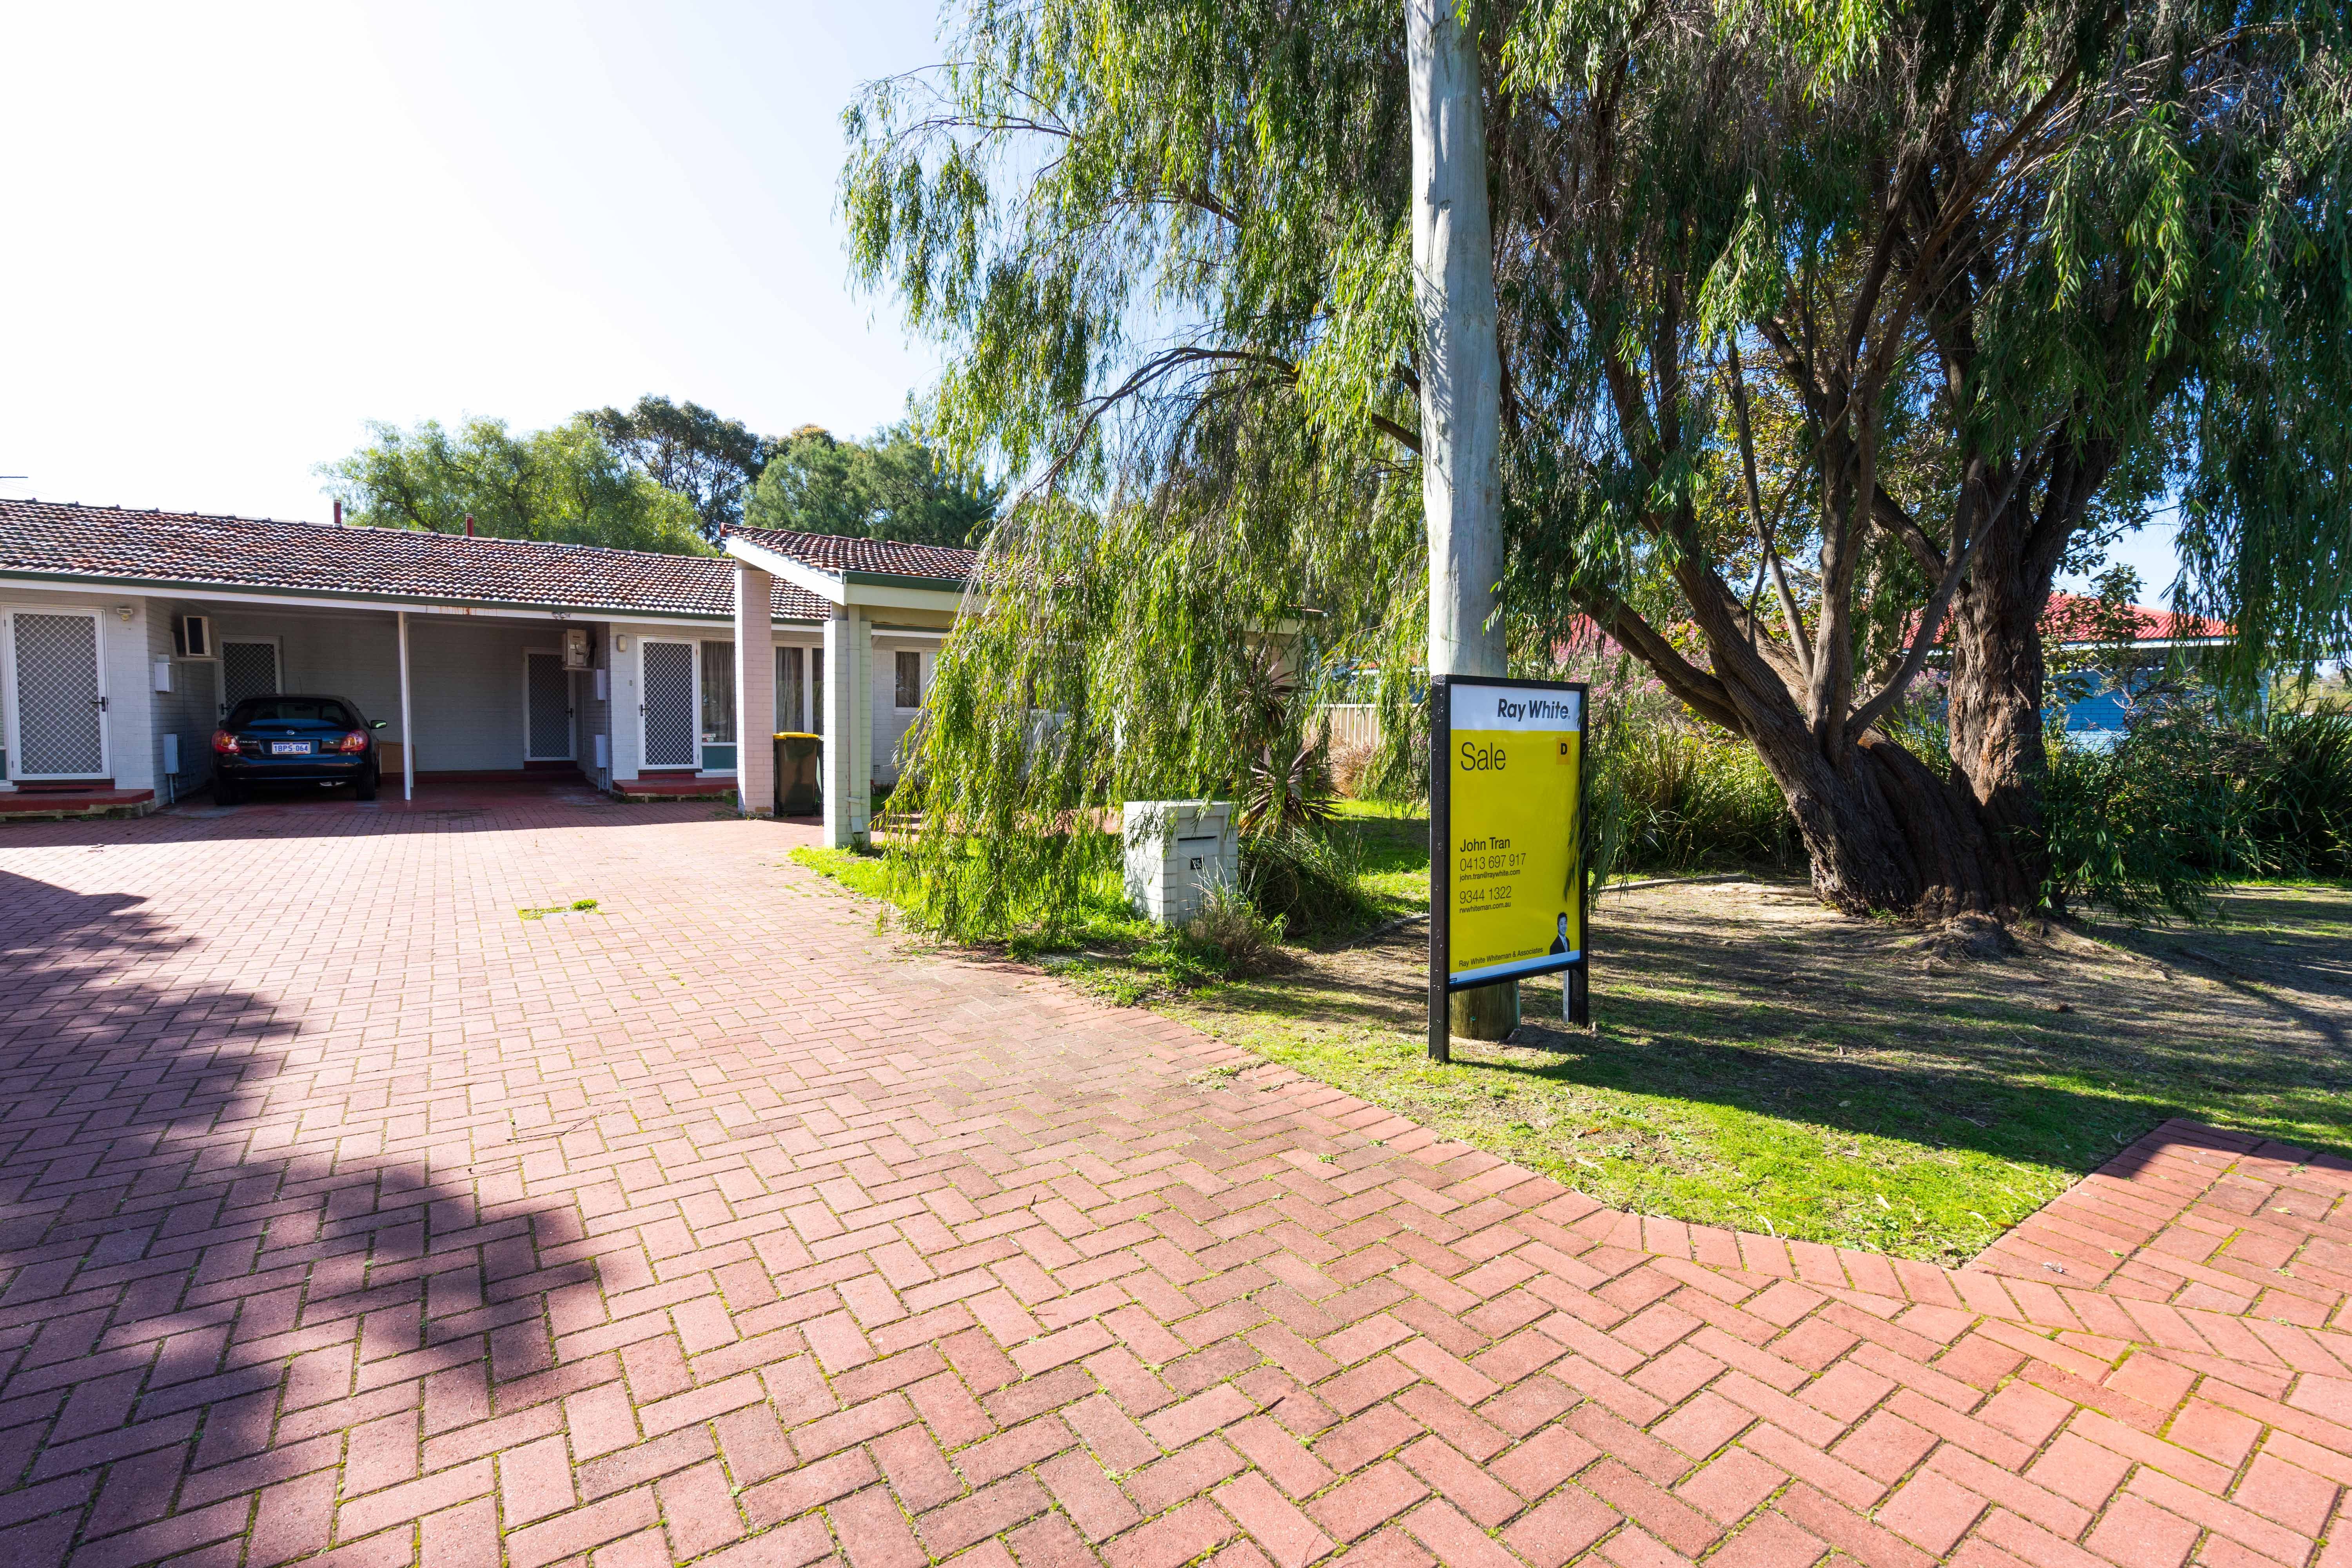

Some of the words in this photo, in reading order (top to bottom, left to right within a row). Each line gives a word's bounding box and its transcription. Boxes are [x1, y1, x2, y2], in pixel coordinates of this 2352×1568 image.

[1497, 698, 1526, 722] Ray
[1461, 742, 1506, 771] Sale
[1561, 743, 1568, 755] D
[1460, 838, 1486, 852] John
[1489, 837, 1510, 850] Tran
[1460, 857, 1486, 871] 0413
[1488, 855, 1506, 868] 697
[1509, 853, 1526, 867] 917
[1459, 869, 1520, 882] john.tran@raywhite.com
[1459, 889, 1485, 904] 9344
[1488, 886, 1512, 900] 1322
[1459, 902, 1511, 913] rwwhiteman.com.au
[1470, 957, 1486, 965] White
[1486, 953, 1512, 962] Whiteman
[1517, 947, 1543, 957] Associates
